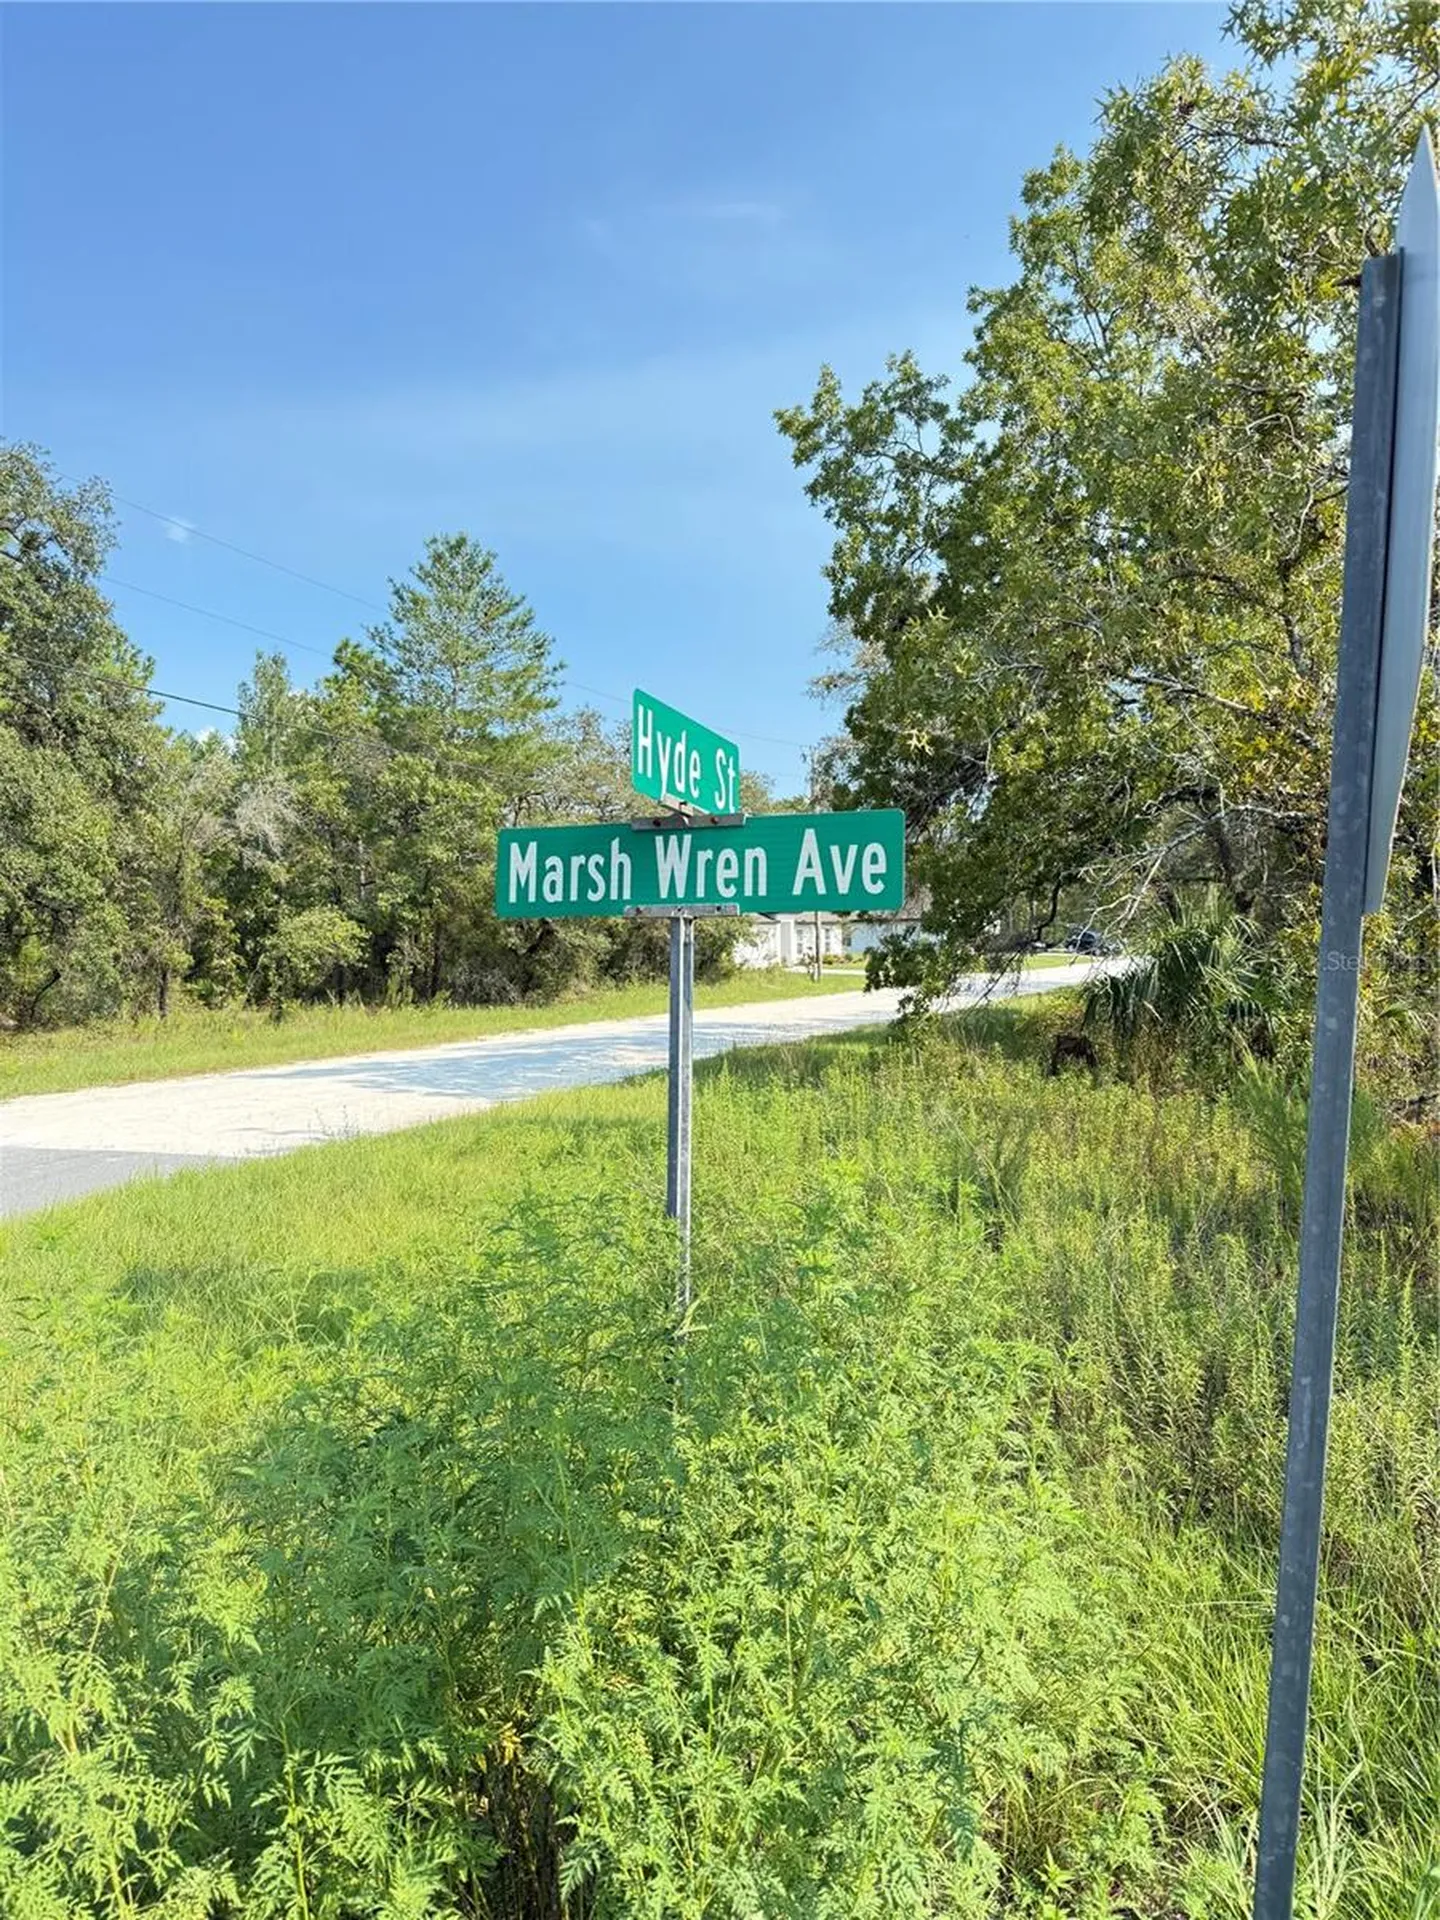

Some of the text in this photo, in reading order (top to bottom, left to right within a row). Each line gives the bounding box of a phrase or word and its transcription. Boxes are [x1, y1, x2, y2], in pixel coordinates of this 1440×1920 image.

[637, 704, 736, 814] Hyde St
[508, 828, 888, 903] Marsh Wren Ave
